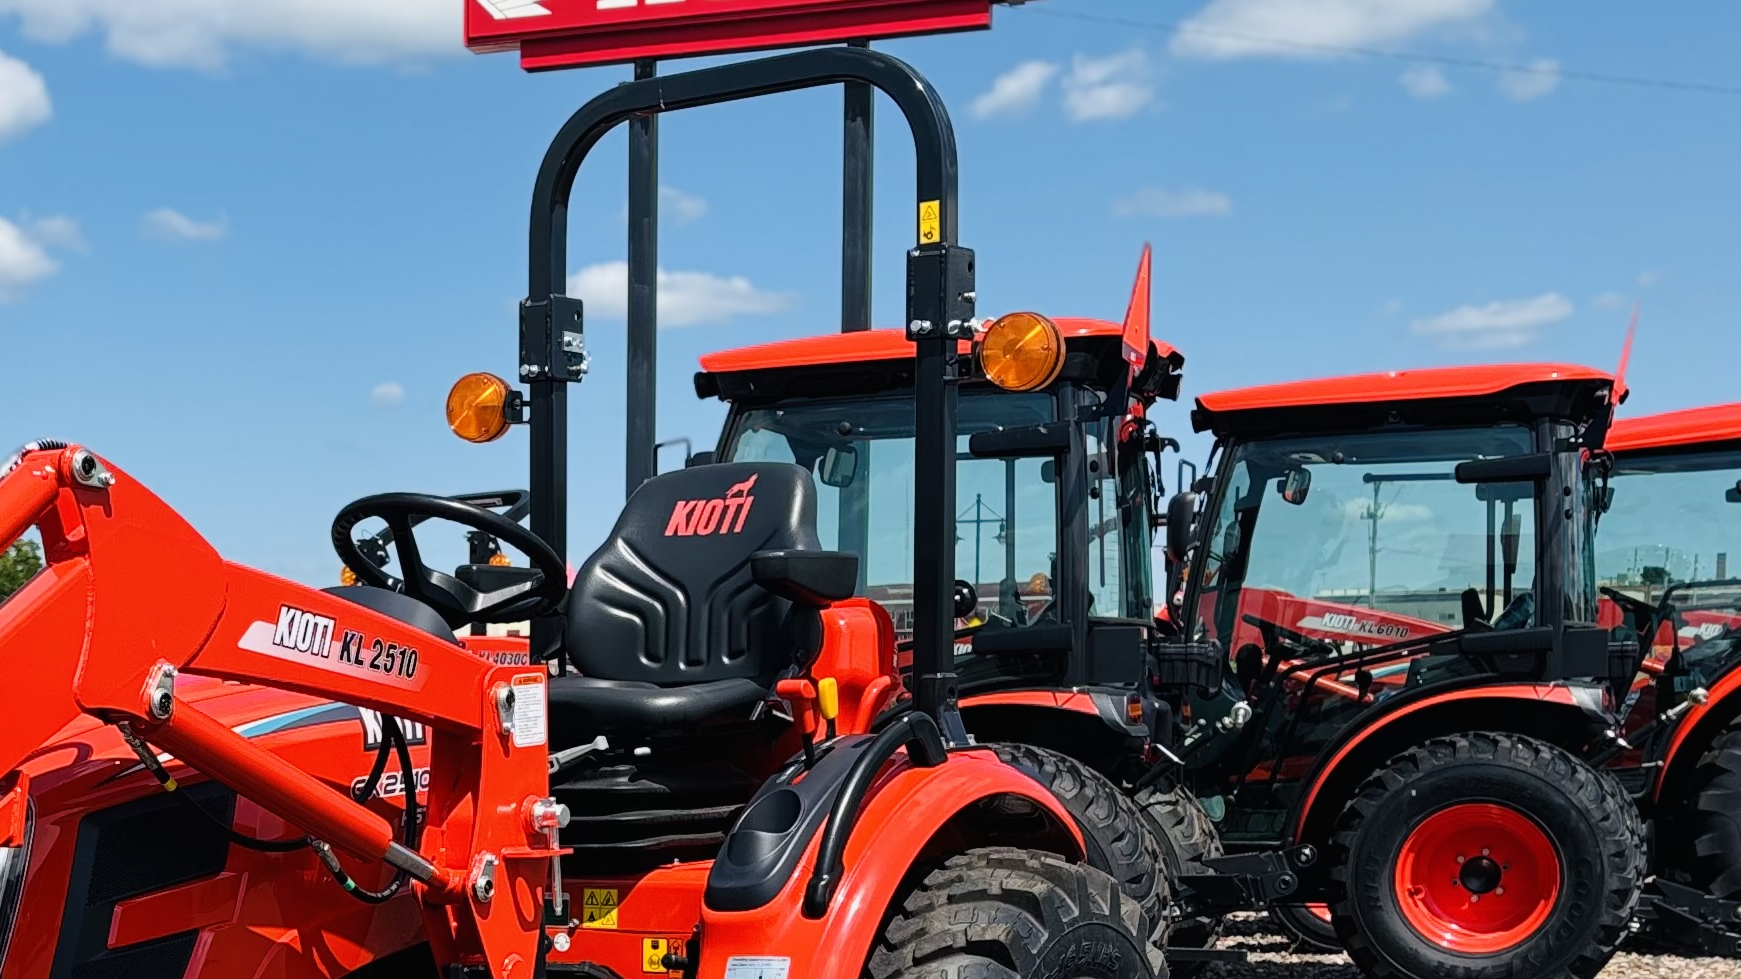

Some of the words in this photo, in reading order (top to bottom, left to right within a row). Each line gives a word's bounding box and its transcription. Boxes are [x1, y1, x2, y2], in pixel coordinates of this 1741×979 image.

[664, 496, 754, 536] KIOTI
[273, 604, 336, 658] KIOTI
[339, 630, 364, 666] KL
[369, 638, 418, 678] 2510
[1321, 612, 1357, 631] KIOTI
